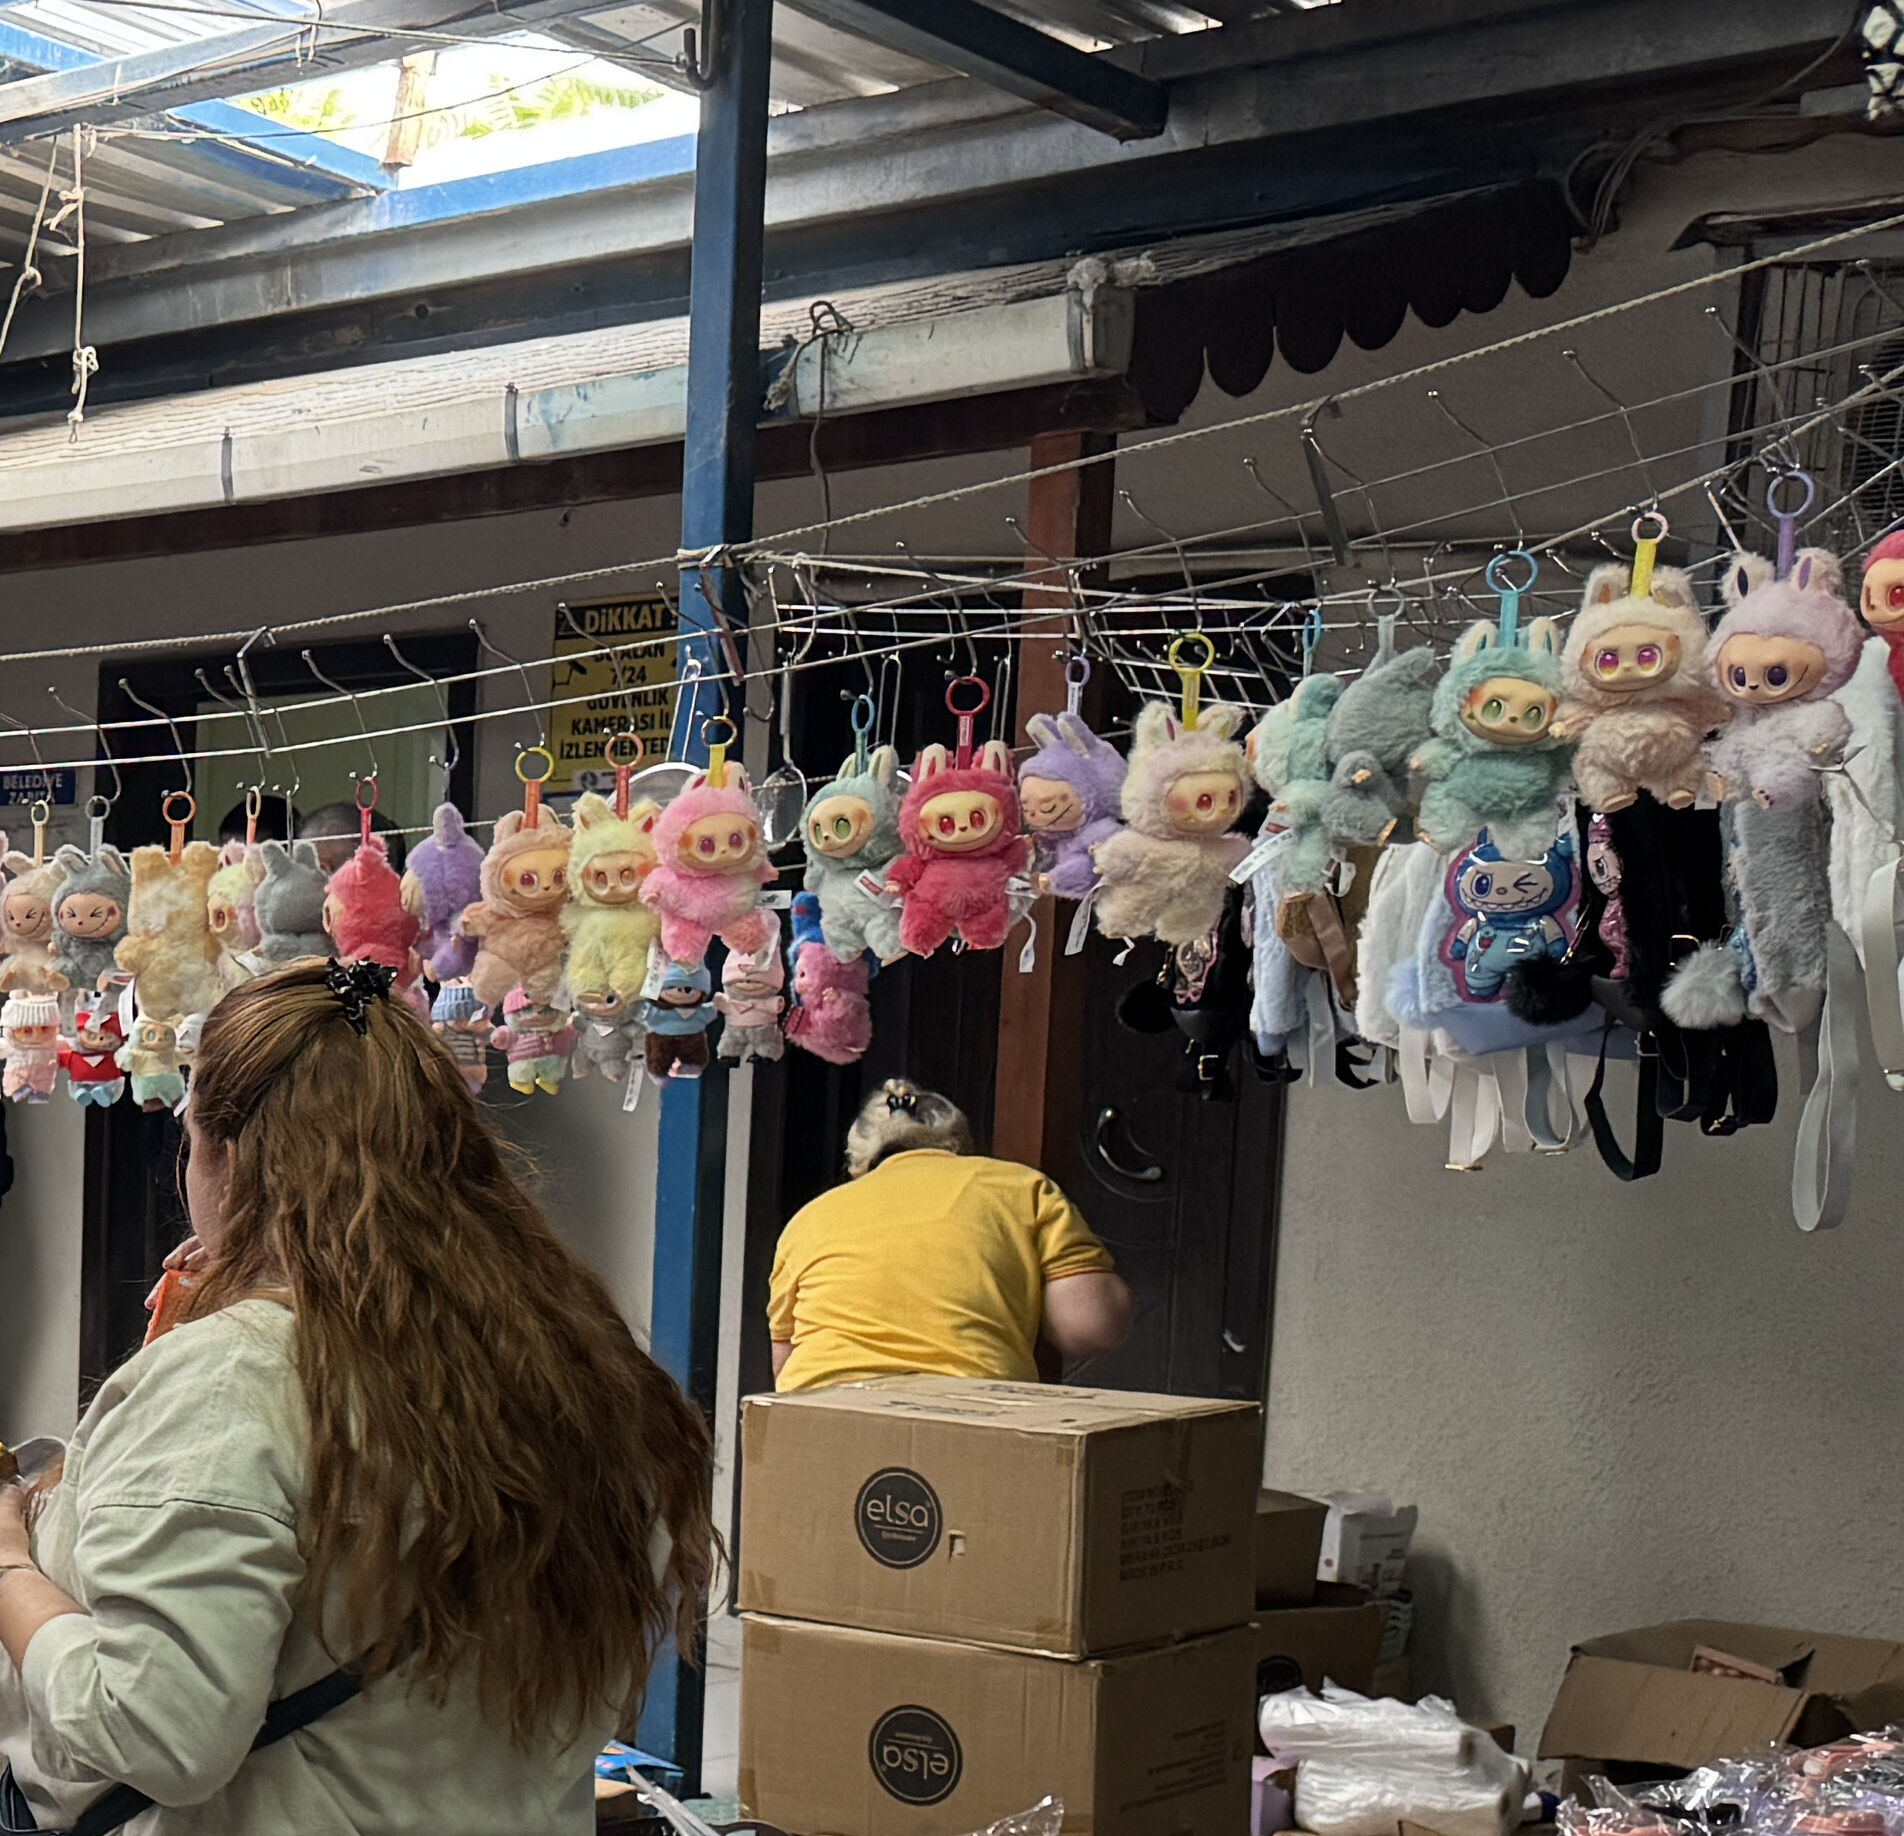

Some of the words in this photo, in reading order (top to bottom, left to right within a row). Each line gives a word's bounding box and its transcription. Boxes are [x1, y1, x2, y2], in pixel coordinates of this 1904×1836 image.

[585, 604, 665, 633] DİKKAT
[587, 685, 669, 711] GÜVNLİK
[866, 1494, 929, 1528] elsa
[882, 1744, 949, 1780] elsa
